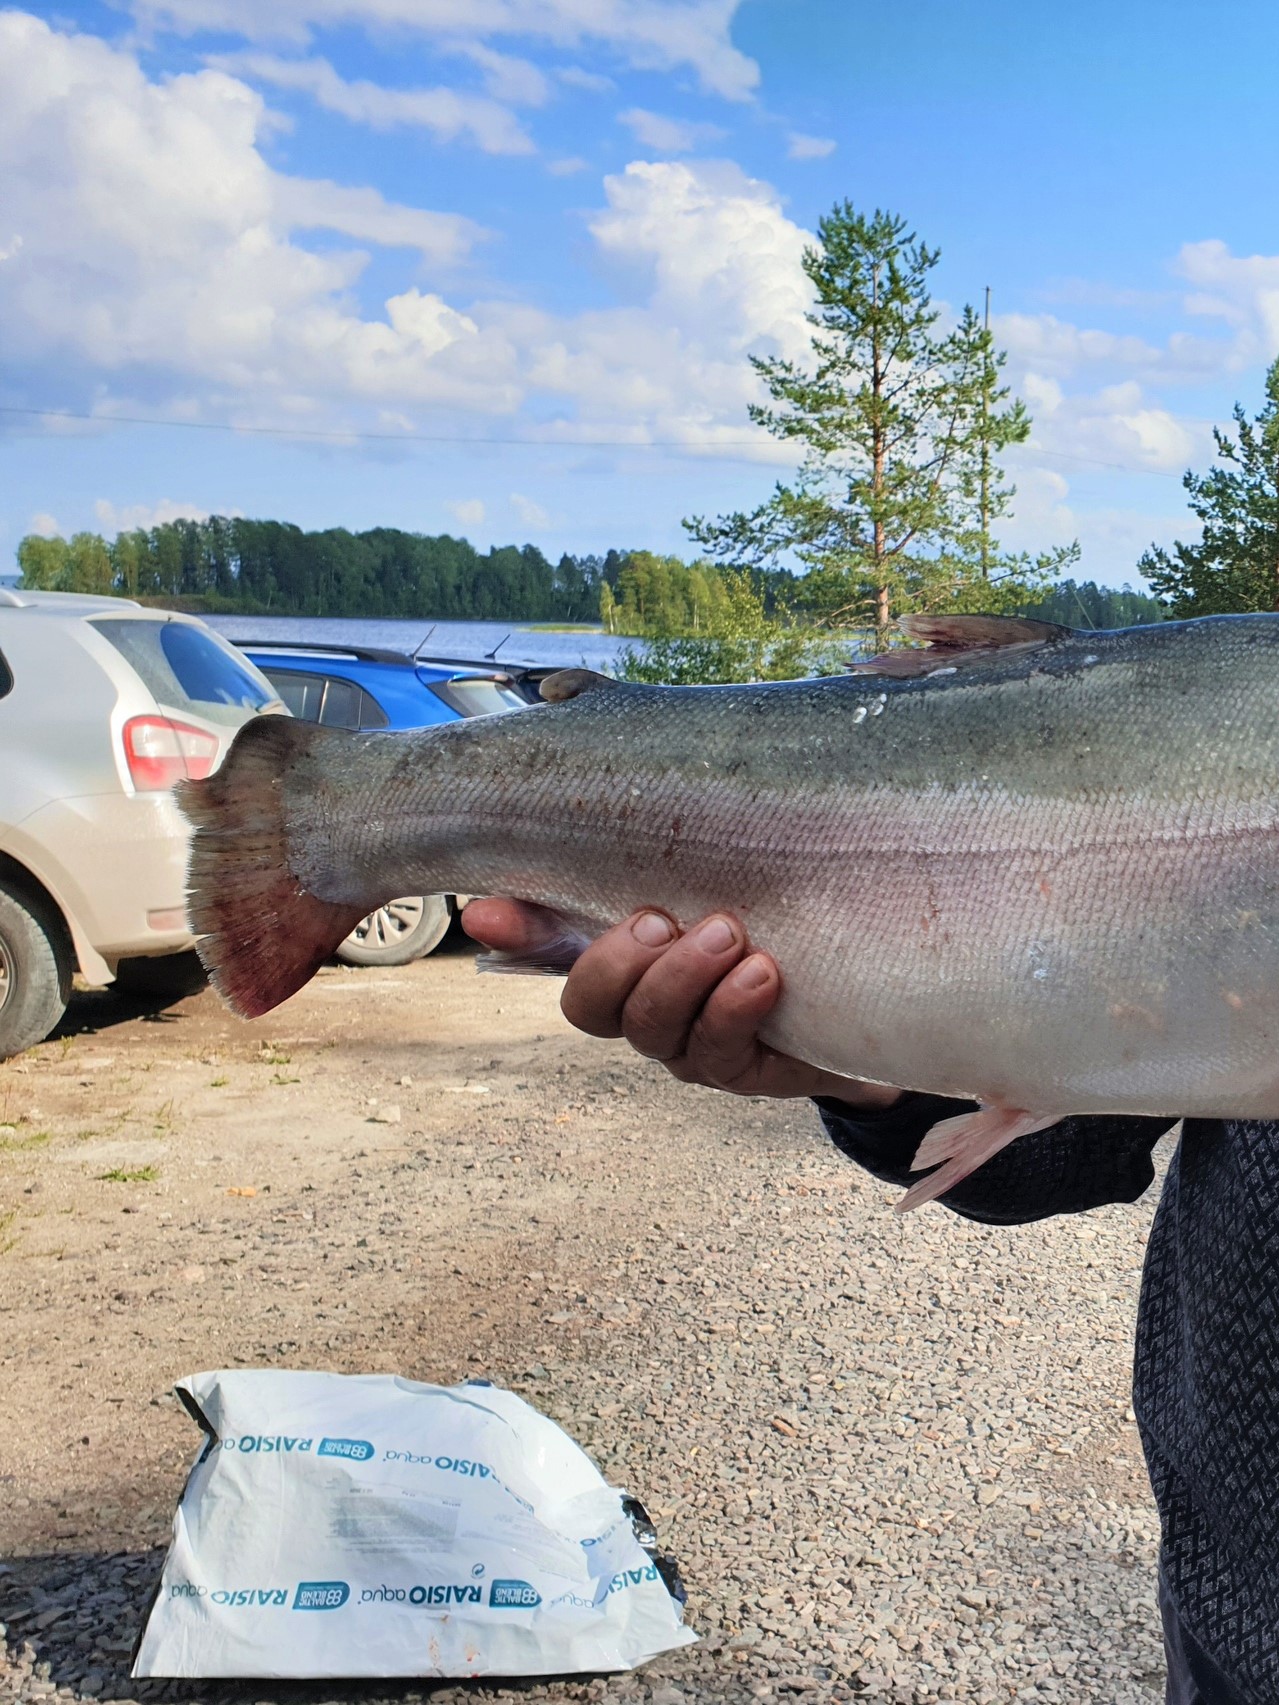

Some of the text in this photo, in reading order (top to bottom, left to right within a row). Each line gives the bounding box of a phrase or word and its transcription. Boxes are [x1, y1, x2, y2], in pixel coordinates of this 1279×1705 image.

[238, 1435, 313, 1453] RAISIO
[385, 1450, 497, 1482] AISIO aqua
[171, 1579, 289, 1606] RAISIO aqua
[301, 1589, 327, 1599] BLEND
[361, 1584, 483, 1605] RAISIO aqua
[496, 1588, 523, 1597] BLEND
[298, 1597, 326, 1606] BALTIC
[495, 1596, 523, 1604] BALTIC
